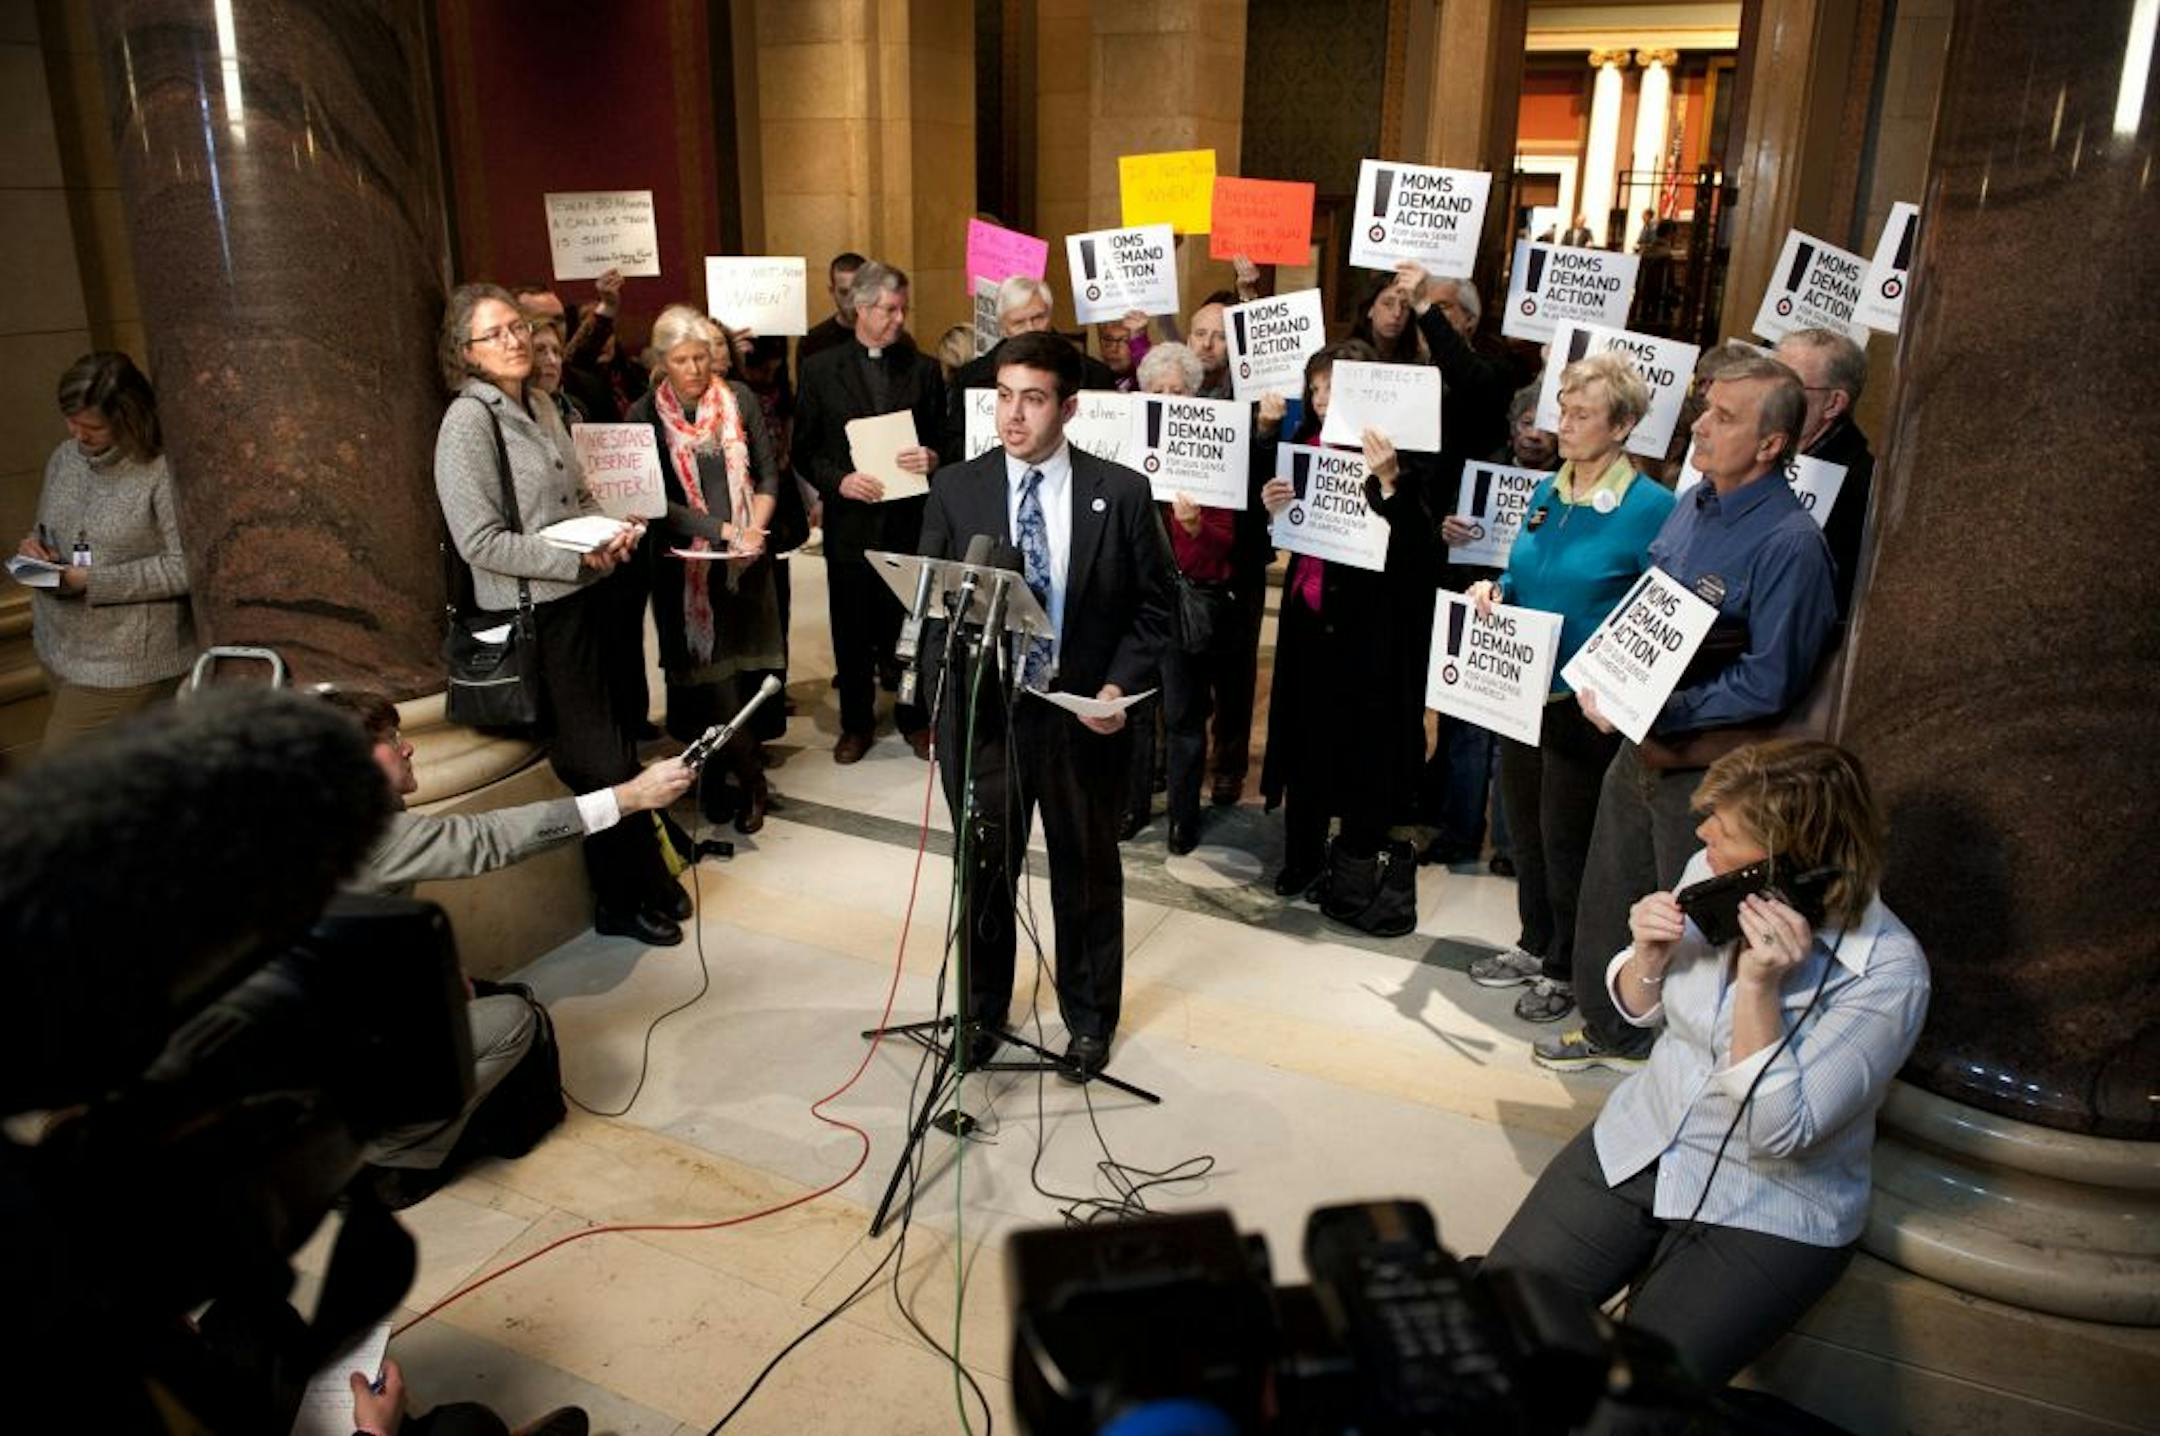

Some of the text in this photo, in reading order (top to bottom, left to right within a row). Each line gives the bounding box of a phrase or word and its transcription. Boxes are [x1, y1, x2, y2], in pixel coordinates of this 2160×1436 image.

[1401, 172, 1454, 192] MOMS
[1398, 191, 1472, 213] DEMAND
[1394, 210, 1458, 230] ACTION
[581, 233, 619, 246] SHOT
[1105, 263, 1155, 281] ATION
[1552, 252, 1603, 272] MOMS
[1816, 251, 1860, 281] MOMS
[1550, 269, 1620, 292] DEMAND
[1810, 270, 1861, 304] DEMAN
[1546, 287, 1606, 307] ACTION
[1803, 288, 1854, 322] ACTION
[1249, 302, 1289, 323] MOMS
[1250, 316, 1310, 340] DEMAND
[1253, 335, 1300, 357] ACTION
[1168, 404, 1215, 422] MOMS
[1168, 421, 1235, 443] DEMAND
[1166, 440, 1223, 460] ACTION
[1318, 456, 1364, 478] MOMS
[1316, 474, 1366, 498] DEMAN
[1498, 474, 1540, 492] MOM
[1312, 493, 1368, 517] ACTION
[1643, 582, 1681, 617] MOMS
[1473, 608, 1516, 637] MOMS
[1628, 601, 1683, 651] DEMAND
[1470, 629, 1534, 664] DEMAND
[1612, 624, 1661, 667] ACTION
[1467, 651, 1521, 683] ACTION
